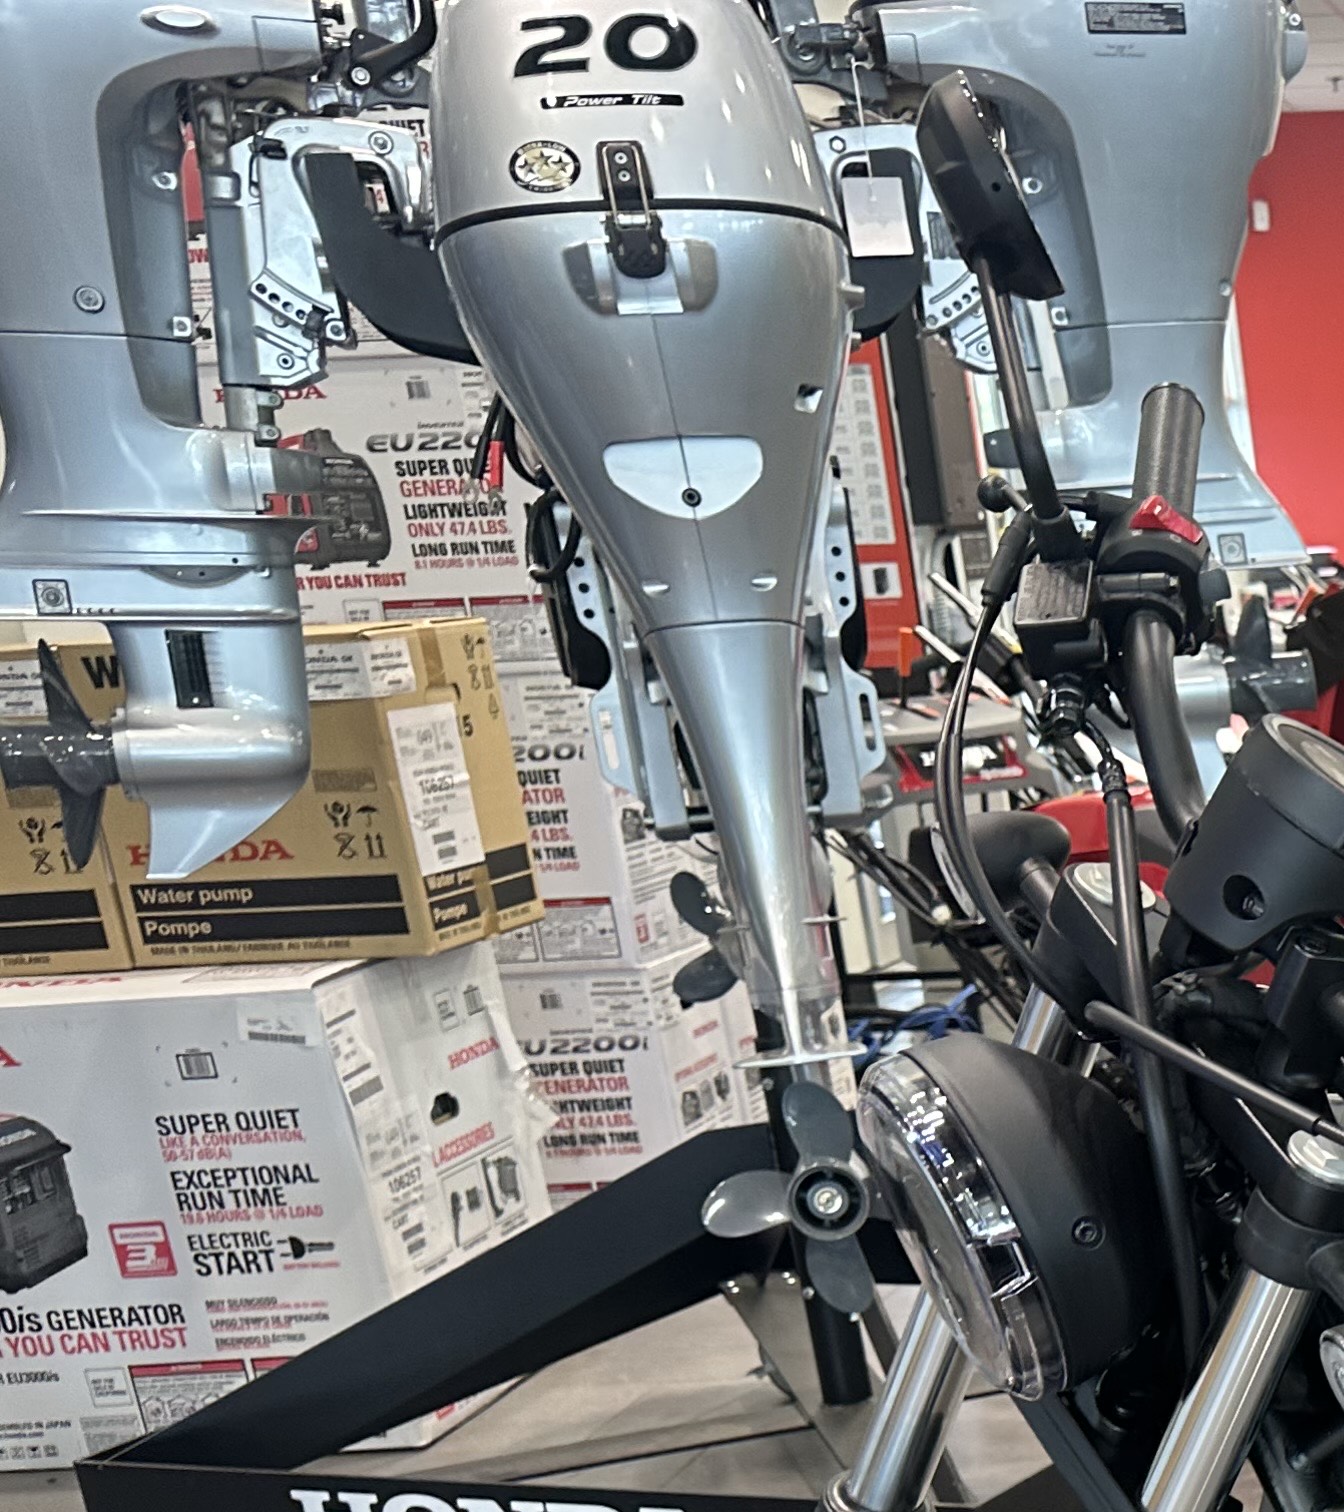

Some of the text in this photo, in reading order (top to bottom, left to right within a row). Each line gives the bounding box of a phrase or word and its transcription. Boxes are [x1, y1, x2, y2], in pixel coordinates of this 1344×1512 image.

[513, 13, 698, 78] 20
[563, 94, 662, 107] Power Tilt
[394, 459, 451, 477] SUPER
[407, 521, 447, 538] ONLY
[479, 520, 513, 536] LBS.
[411, 540, 517, 558] LONG RUN TIME
[305, 572, 408, 591] YOU CAN TRUST
[517, 768, 561, 788] QUIET
[544, 846, 577, 860] TIME
[138, 886, 254, 907] Water pump
[144, 920, 213, 939] Pompe
[447, 1037, 500, 1070] HONDA
[520, 1034, 649, 1056] U2200i
[529, 1058, 626, 1078] SUPER QUIET
[540, 1076, 630, 1096] ENERATOR
[556, 1096, 633, 1114] HTWEIGHT
[154, 1107, 300, 1137] SUPER QUIET
[159, 1136, 187, 1150] LIKE
[190, 1136, 200, 1148] A
[579, 1133, 607, 1146] RUN
[609, 1131, 640, 1144] TIME
[170, 1162, 320, 1191] EXCEPTIONAL
[175, 1186, 288, 1213] RUN TIME
[206, 1210, 251, 1223] HOURS
[289, 1205, 325, 1218] LOAD
[187, 1230, 273, 1252] ELECTRIC
[193, 1249, 276, 1278] START
[47, 1303, 186, 1331] GENERATOR
[5, 1327, 188, 1358] YOU CAN TRUST
